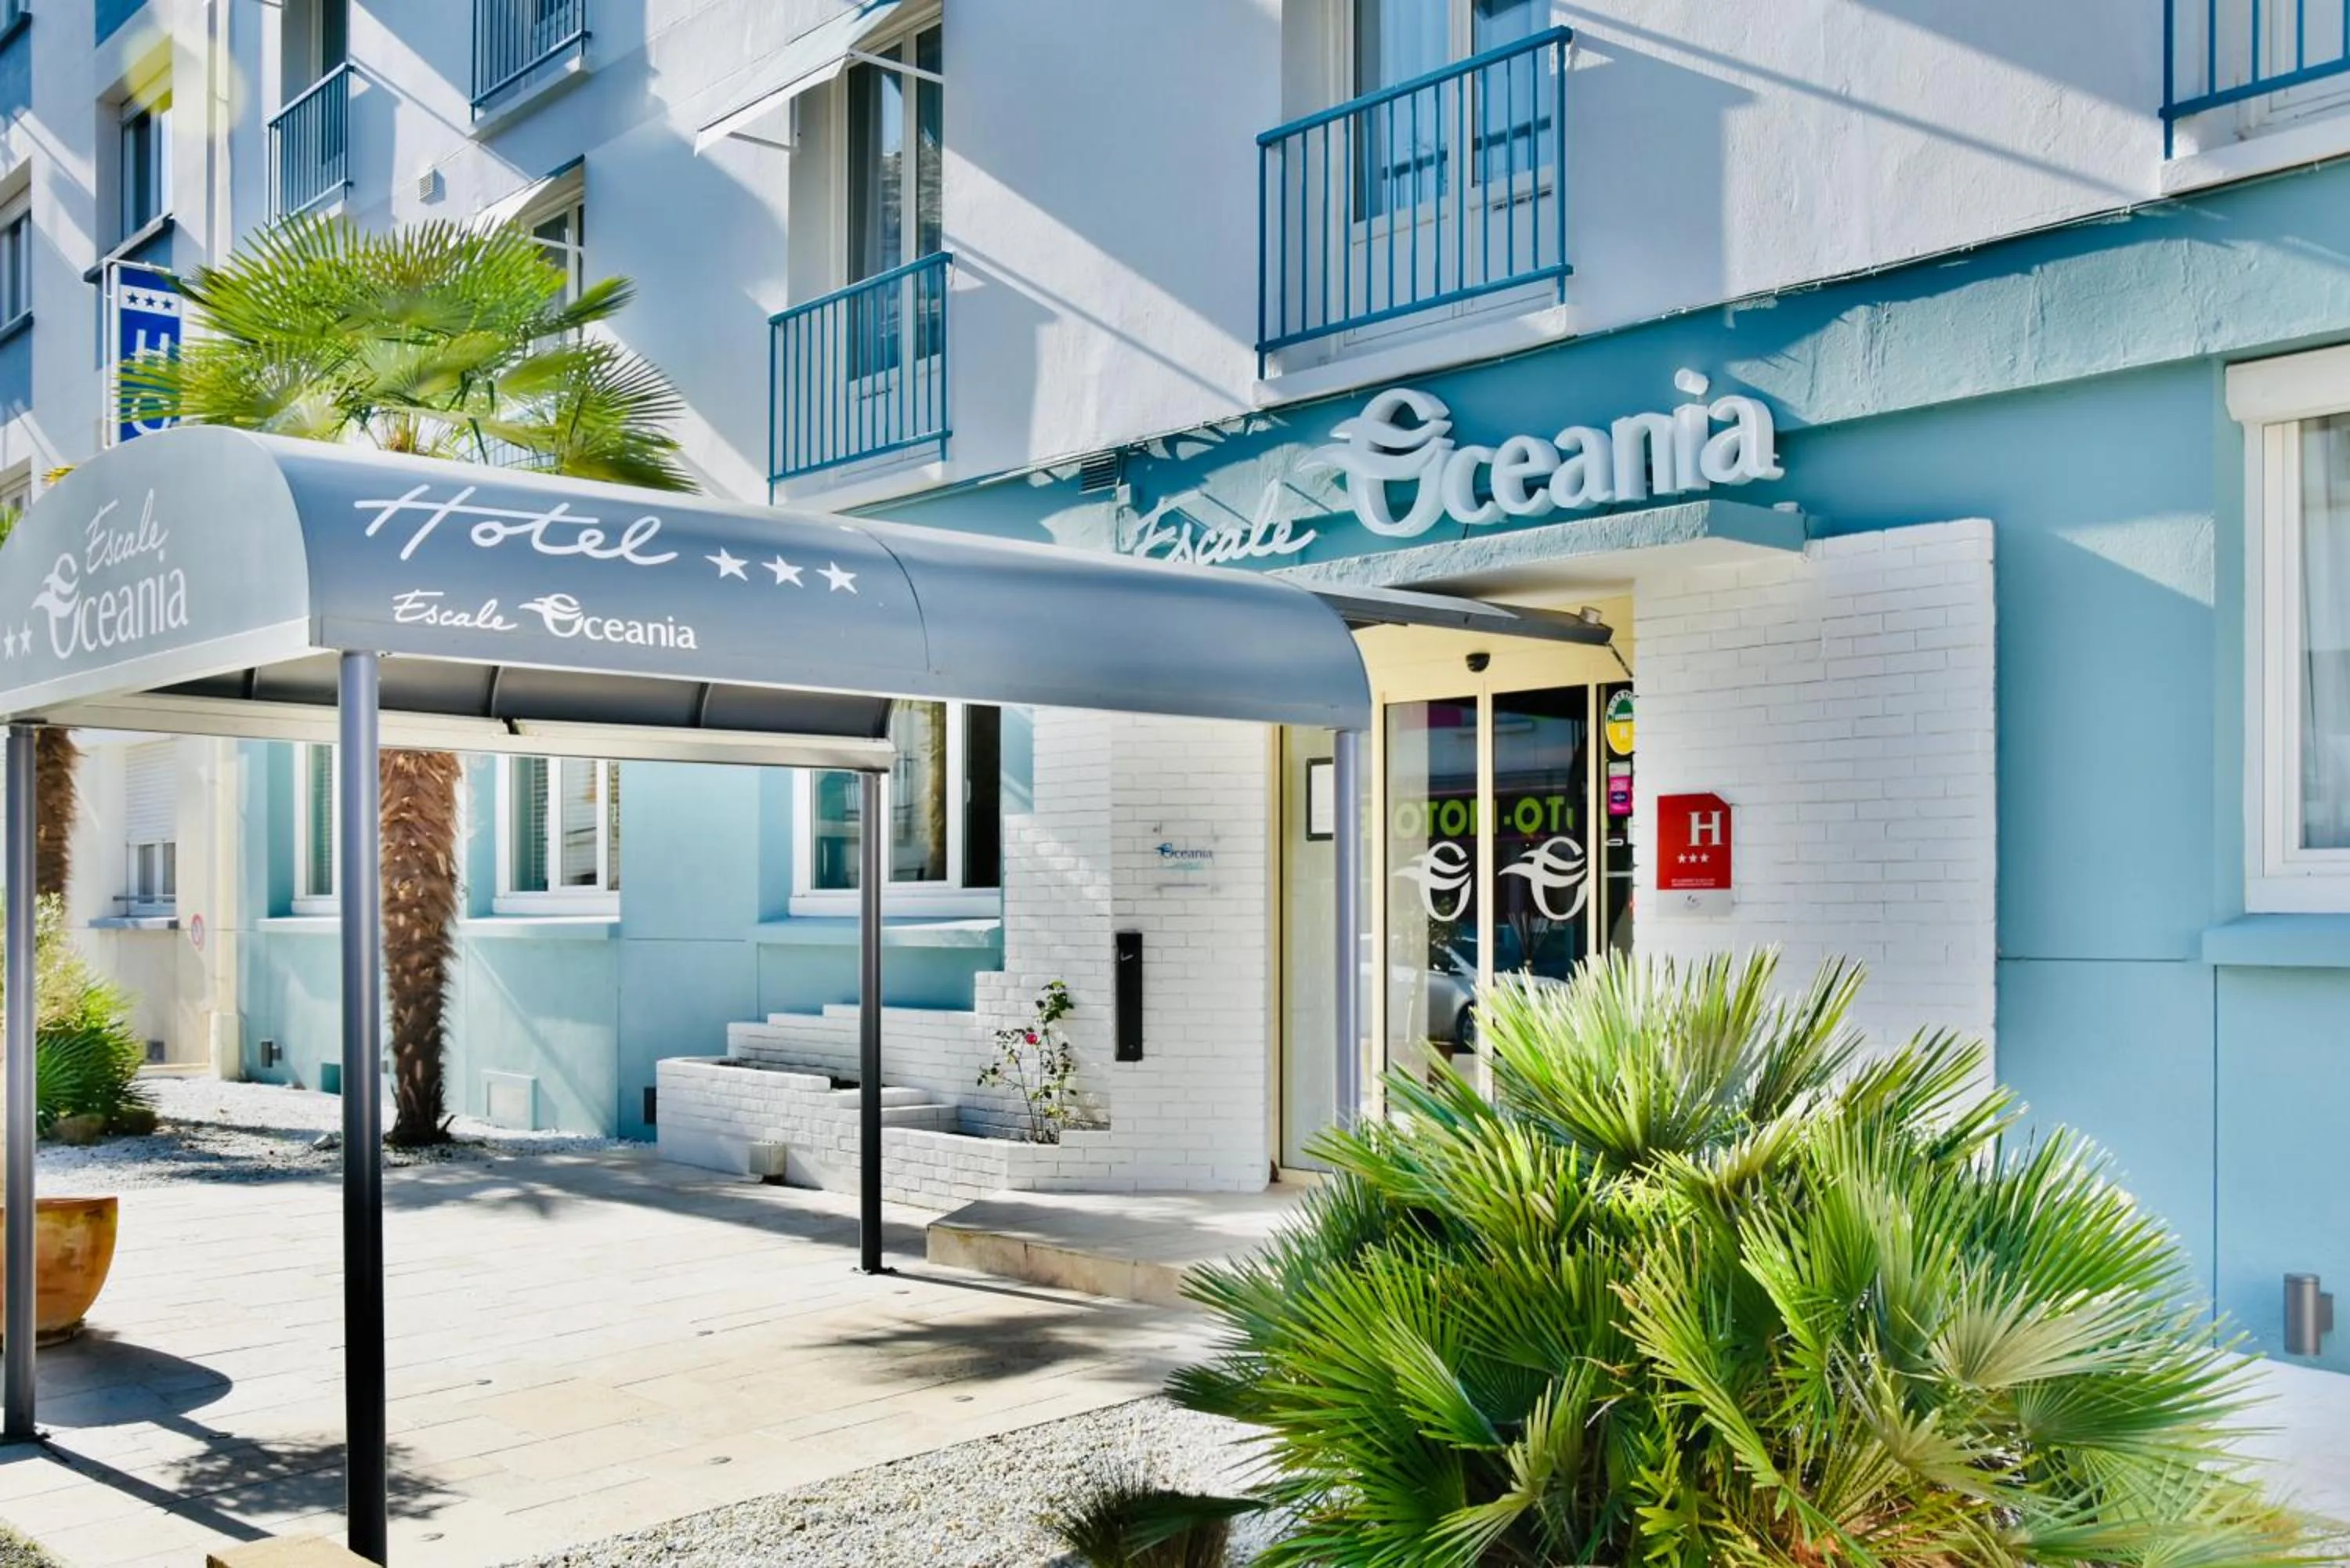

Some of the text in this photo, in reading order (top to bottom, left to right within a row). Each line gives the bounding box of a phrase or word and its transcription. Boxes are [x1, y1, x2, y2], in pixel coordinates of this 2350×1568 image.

[1128, 368, 1785, 566] Escale Oceania
[85, 488, 169, 575] Escale
[354, 483, 679, 562] Hotel
[31, 548, 189, 659] Oceania
[392, 588, 698, 649] Escale Oceania
[1153, 842, 1213, 859] Oceania
[1686, 811, 1723, 847] H
